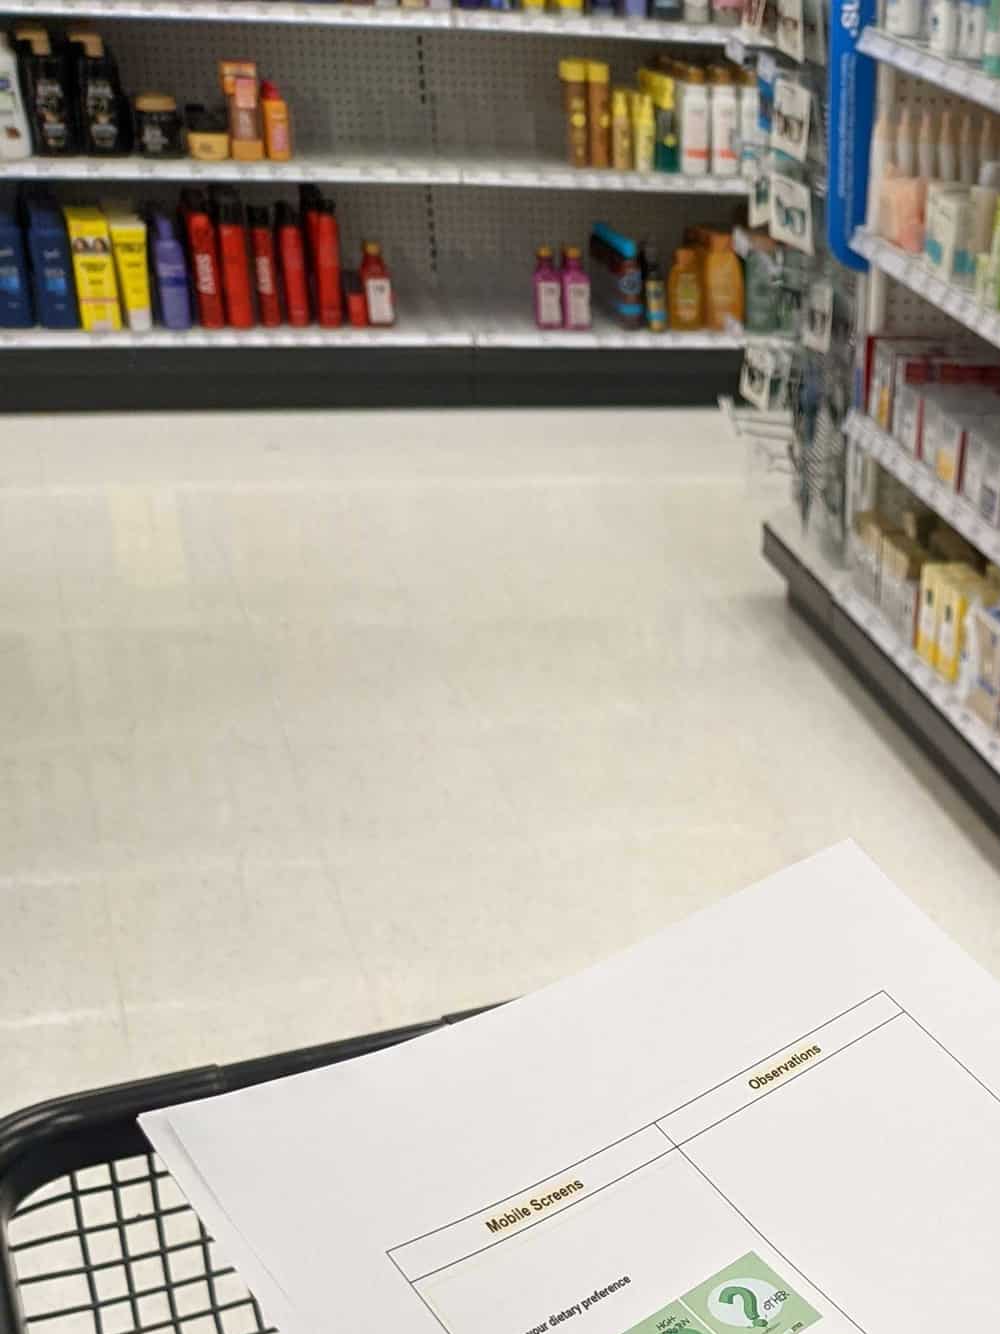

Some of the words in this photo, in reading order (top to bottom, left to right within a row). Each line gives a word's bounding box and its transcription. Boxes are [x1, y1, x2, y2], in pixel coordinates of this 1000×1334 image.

[748, 1044, 822, 1090] Observations
[485, 1205, 531, 1233] Mobile
[529, 1178, 585, 1211] Screens
[548, 1303, 582, 1328] dietary
[581, 1275, 632, 1310] preference
[762, 1290, 790, 1311] OTHER
